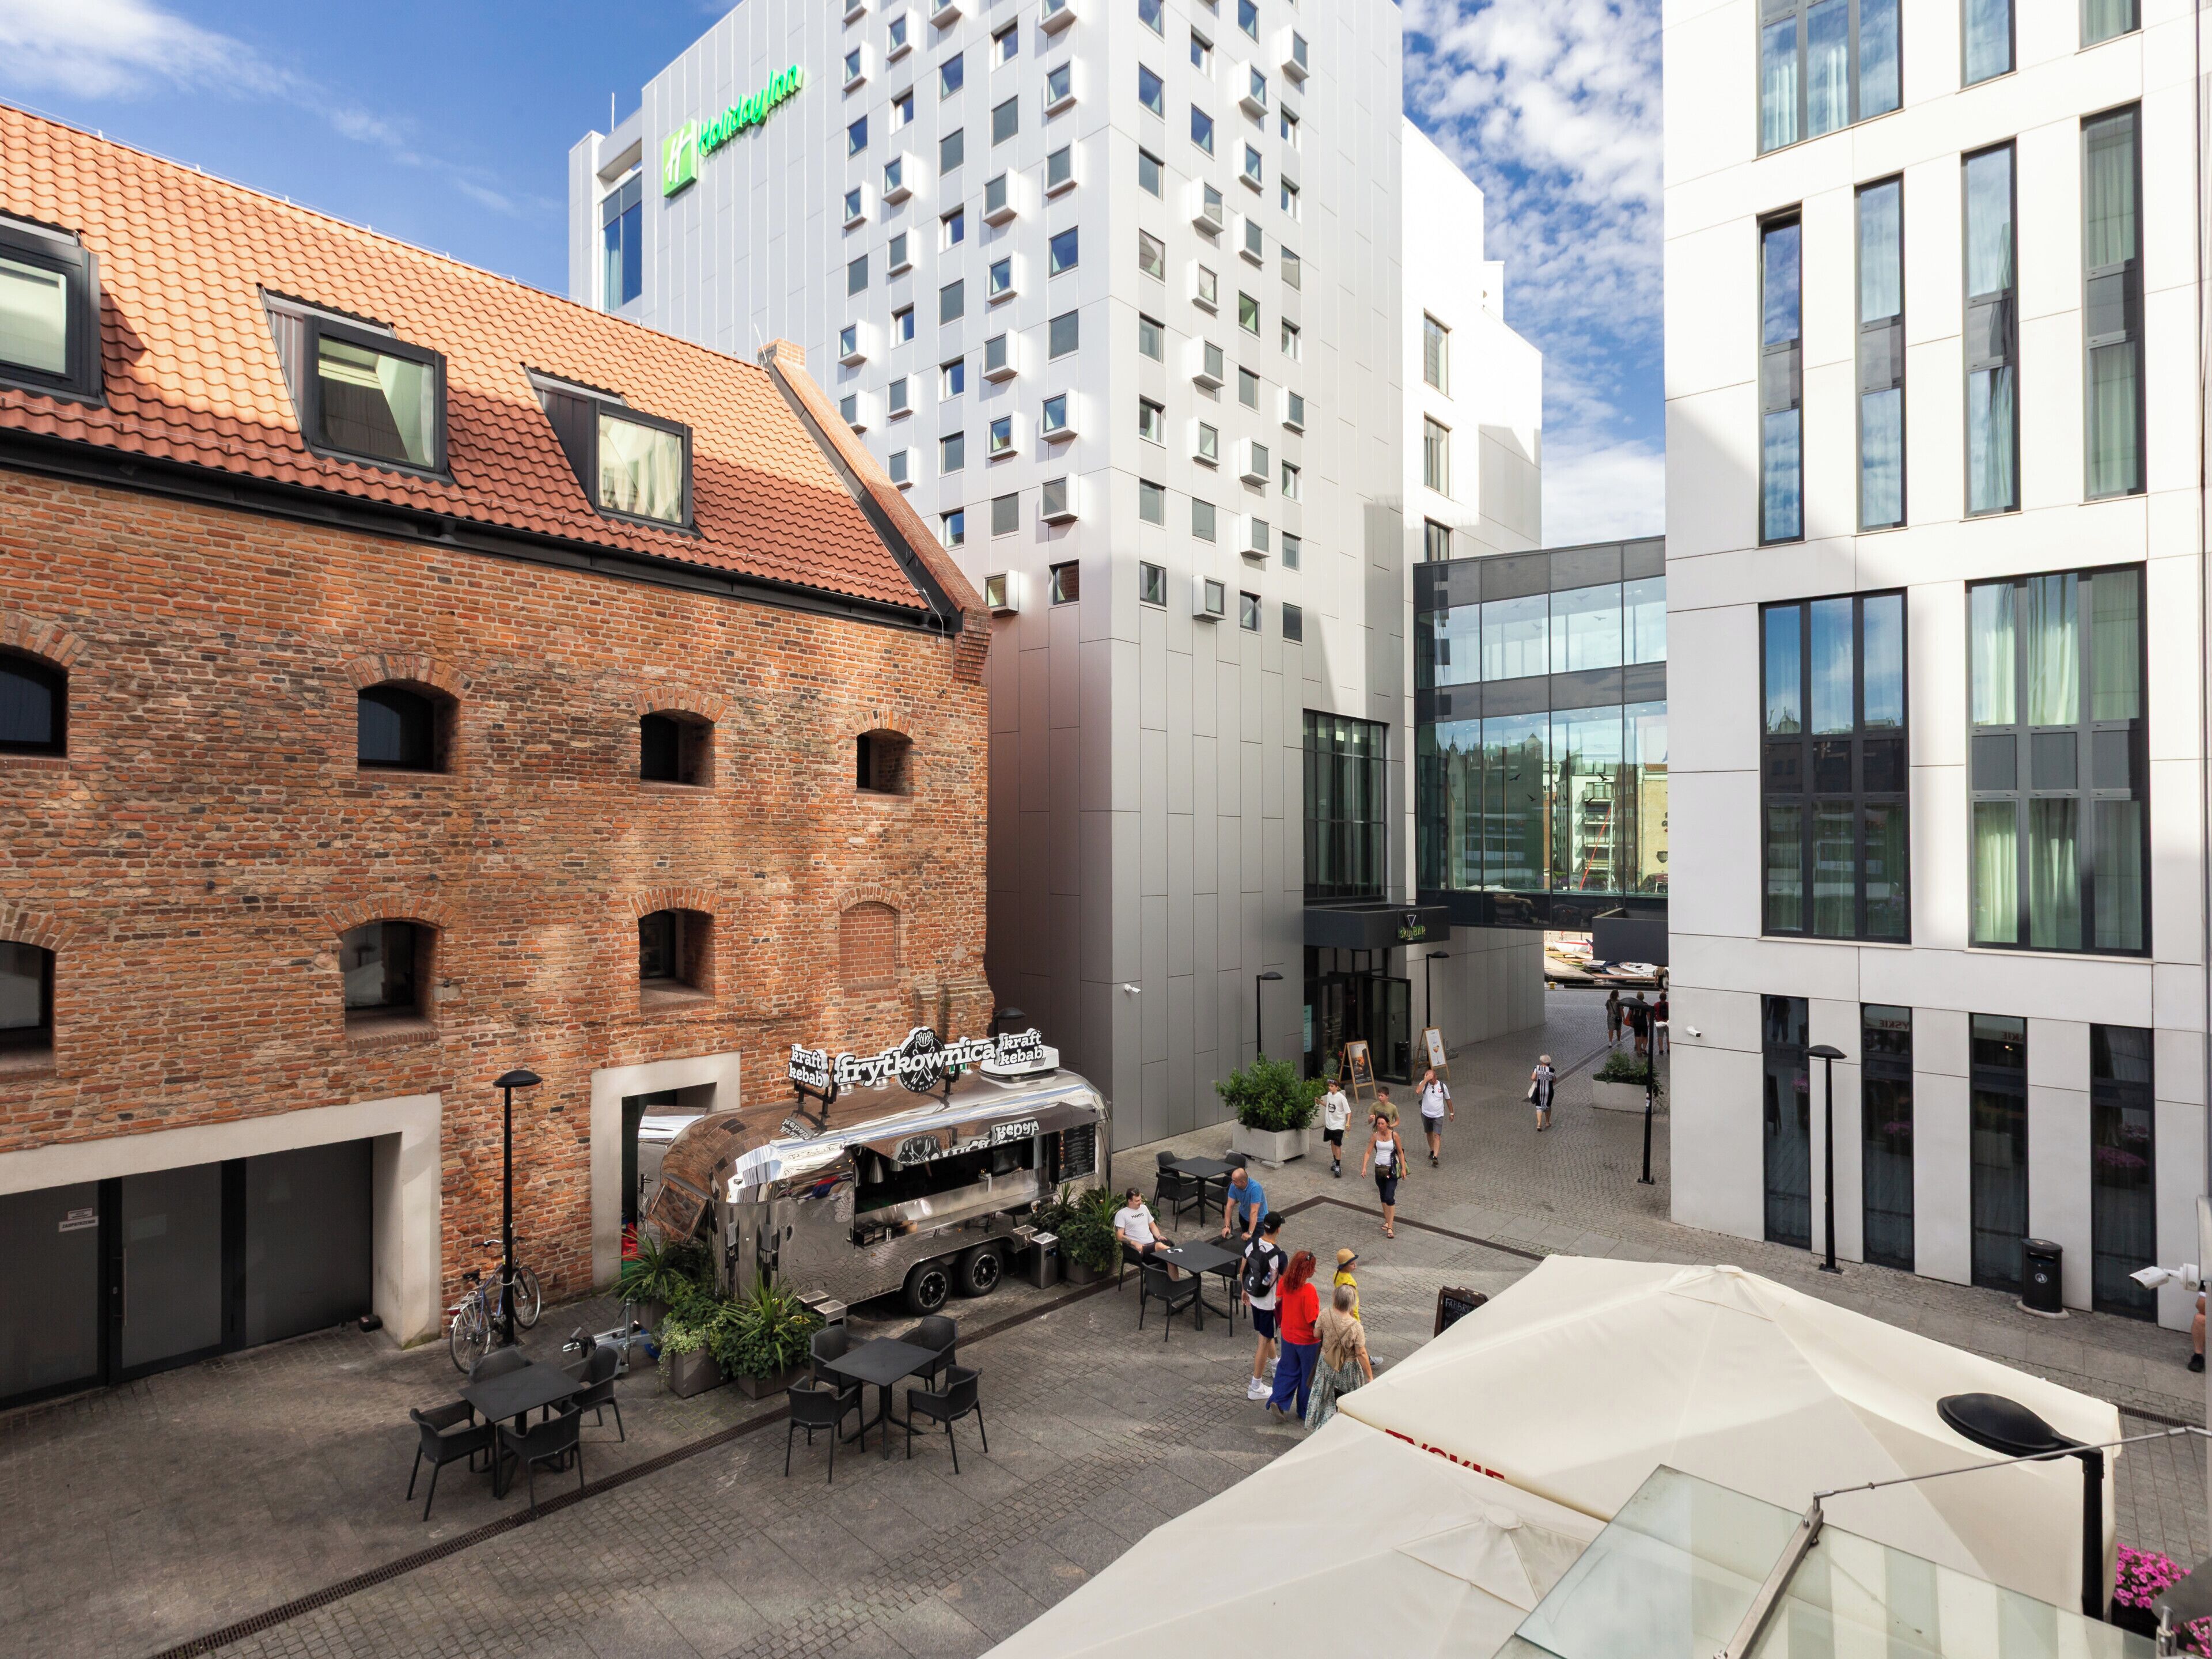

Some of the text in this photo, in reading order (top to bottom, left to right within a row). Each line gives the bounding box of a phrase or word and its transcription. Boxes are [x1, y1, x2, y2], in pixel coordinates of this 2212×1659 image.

[698, 65, 797, 154] Holiday Inn
[1413, 926, 1426, 936] BAR
[1003, 1030, 1042, 1050] kraft
[791, 1046, 821, 1070] kraft
[838, 1040, 996, 1087] frytkownica
[999, 1046, 1043, 1066] kebab
[789, 1062, 823, 1087] kebab
[904, 1075, 940, 1091] BON VIVANT
